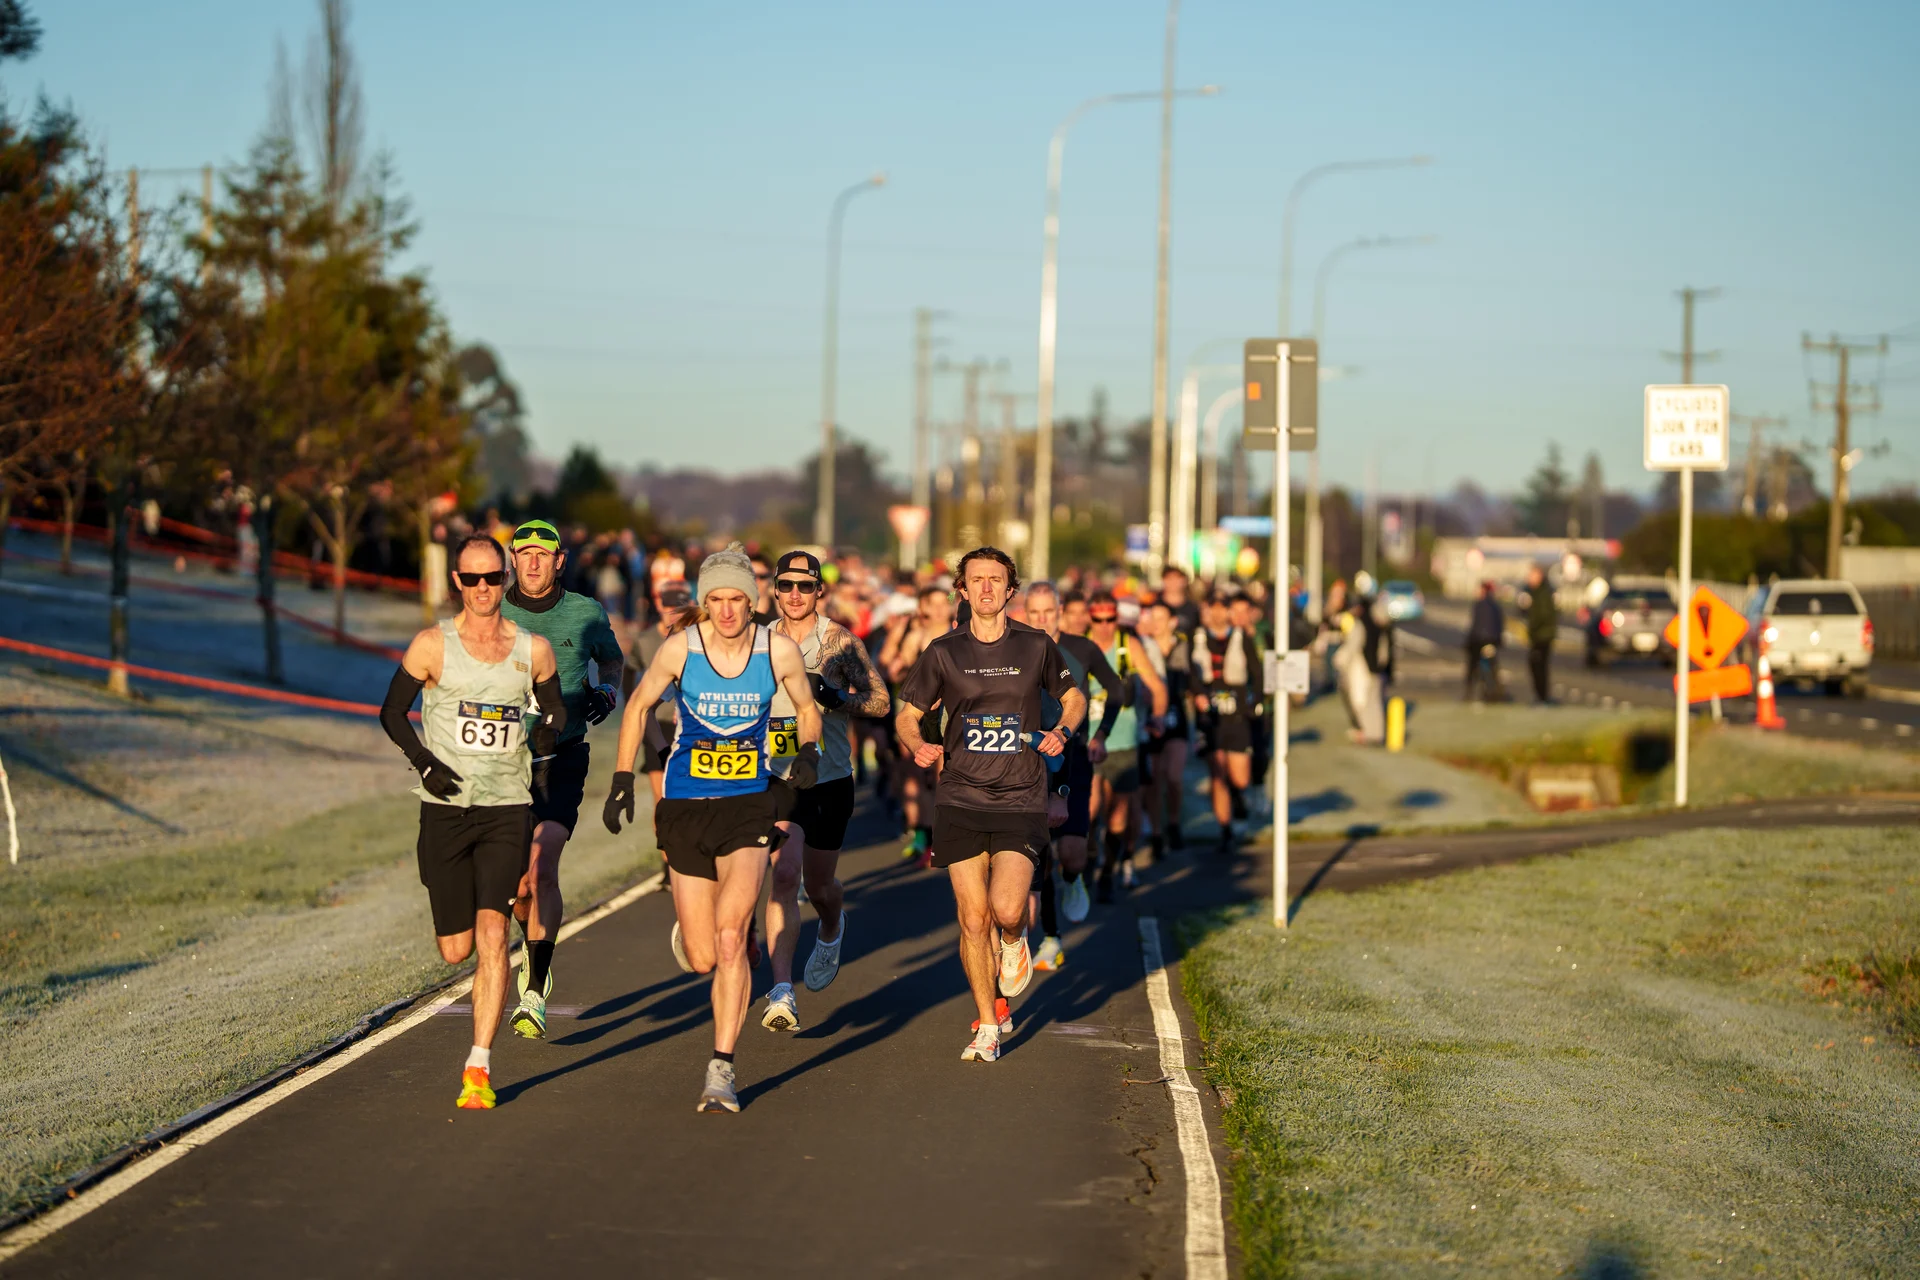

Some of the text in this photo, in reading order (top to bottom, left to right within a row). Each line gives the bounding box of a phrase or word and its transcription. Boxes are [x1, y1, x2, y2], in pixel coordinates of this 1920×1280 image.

[1694, 418, 1719, 434] FOR
[1670, 440, 1704, 456] CARS
[699, 692, 761, 702] ATHLETICS
[697, 703, 760, 717] NELSON
[461, 720, 510, 748] 631
[774, 732, 800, 755] 91
[967, 729, 1016, 752] 222
[697, 752, 752, 776] 962
